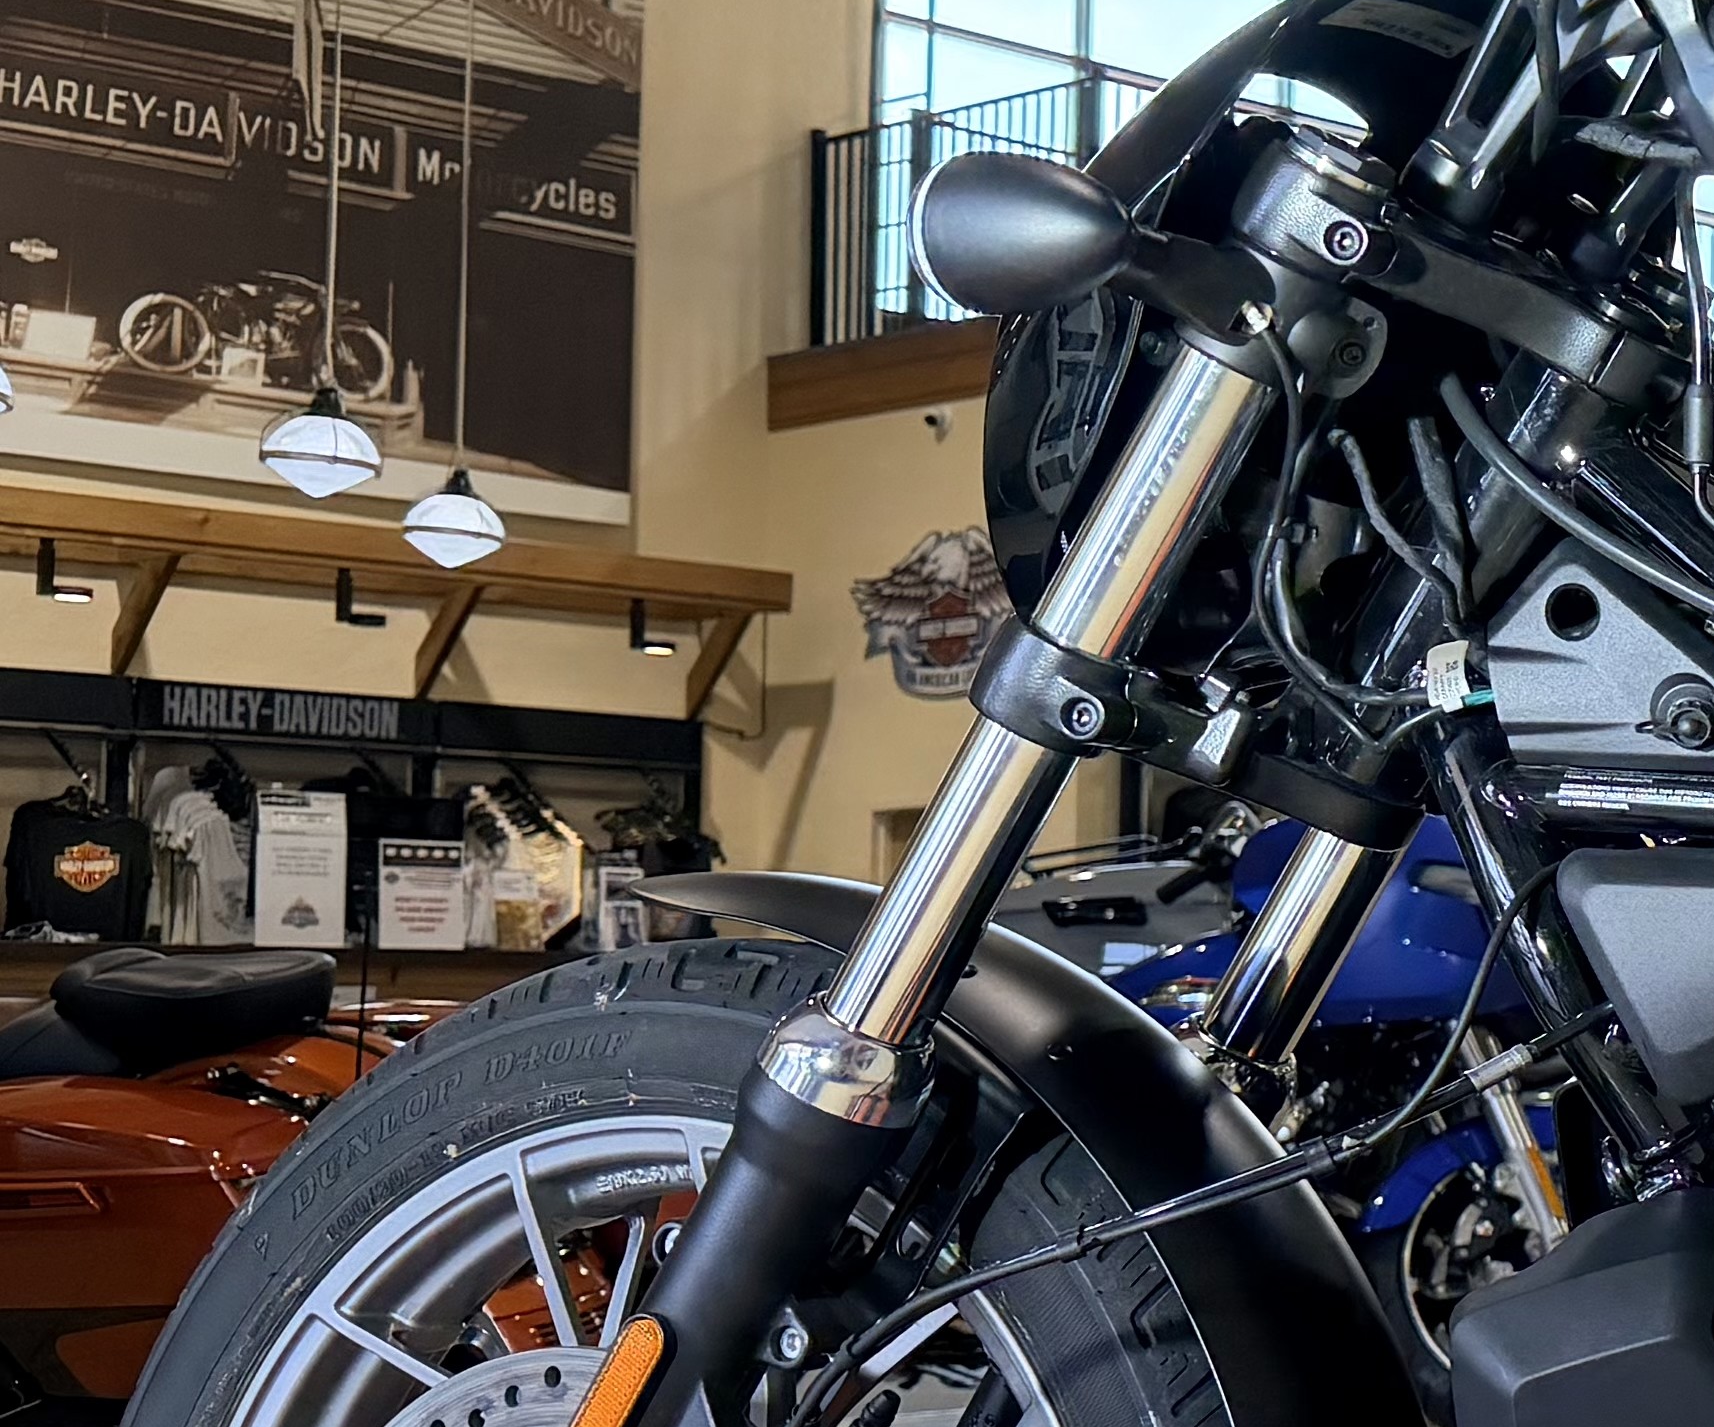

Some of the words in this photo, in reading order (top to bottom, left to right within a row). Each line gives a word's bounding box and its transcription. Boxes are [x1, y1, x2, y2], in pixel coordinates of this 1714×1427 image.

[0, 67, 382, 174] HARLEY-DAVIDSON
[162, 685, 399, 740] HARLEY-DAVIDSON
[289, 1072, 463, 1221] DUNLOP
